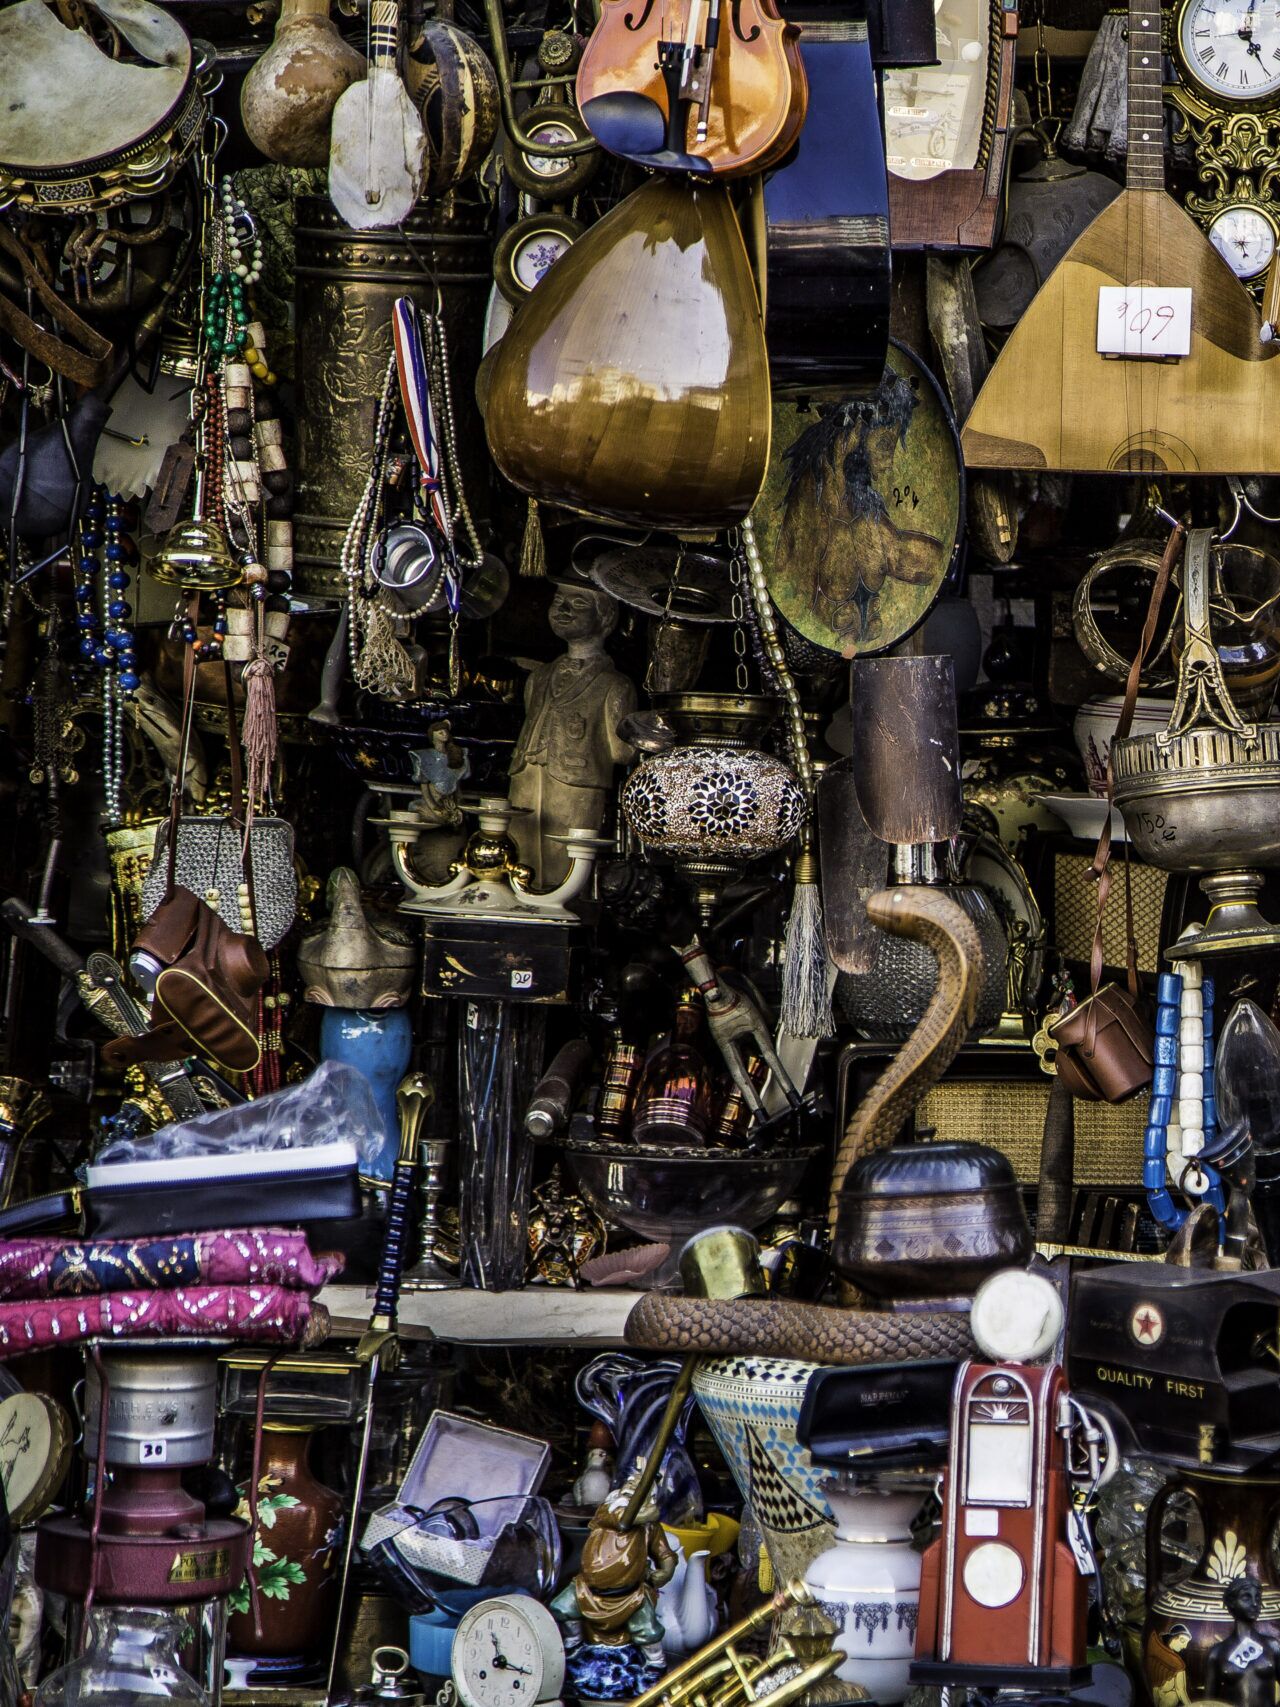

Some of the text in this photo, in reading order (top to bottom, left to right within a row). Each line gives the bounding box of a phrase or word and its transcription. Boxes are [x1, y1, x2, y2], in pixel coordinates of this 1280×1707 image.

[1195, 29, 1210, 38] IX
[1199, 46, 1216, 64] VIII
[1216, 62, 1229, 80] VII
[1240, 69, 1249, 84] VI
[1097, 1367, 1205, 1399] QUALITY FIRST
[143, 1444, 163, 1458] 30
[500, 1616, 510, 1629] 12
[1235, 1645, 1256, 1666] 200
